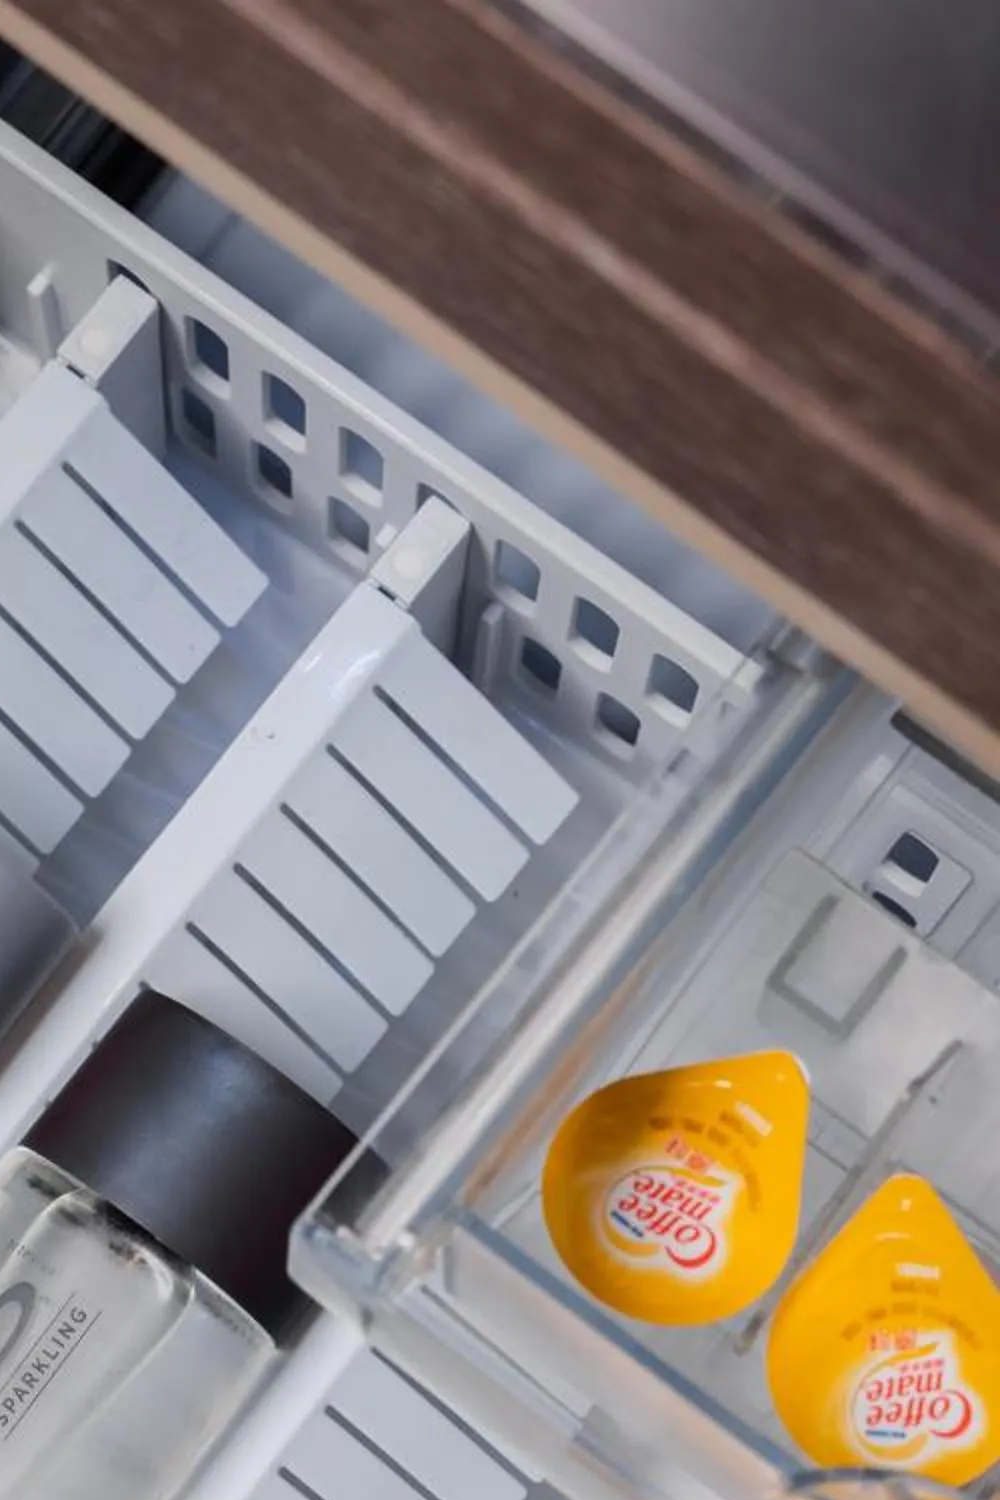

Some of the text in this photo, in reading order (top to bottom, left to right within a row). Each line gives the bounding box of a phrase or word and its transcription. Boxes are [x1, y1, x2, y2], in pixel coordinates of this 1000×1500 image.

[633, 1175, 713, 1221] mate
[618, 1194, 717, 1269] Coffee
[866, 1370, 944, 1402] mate
[866, 1388, 972, 1440] Coffee
